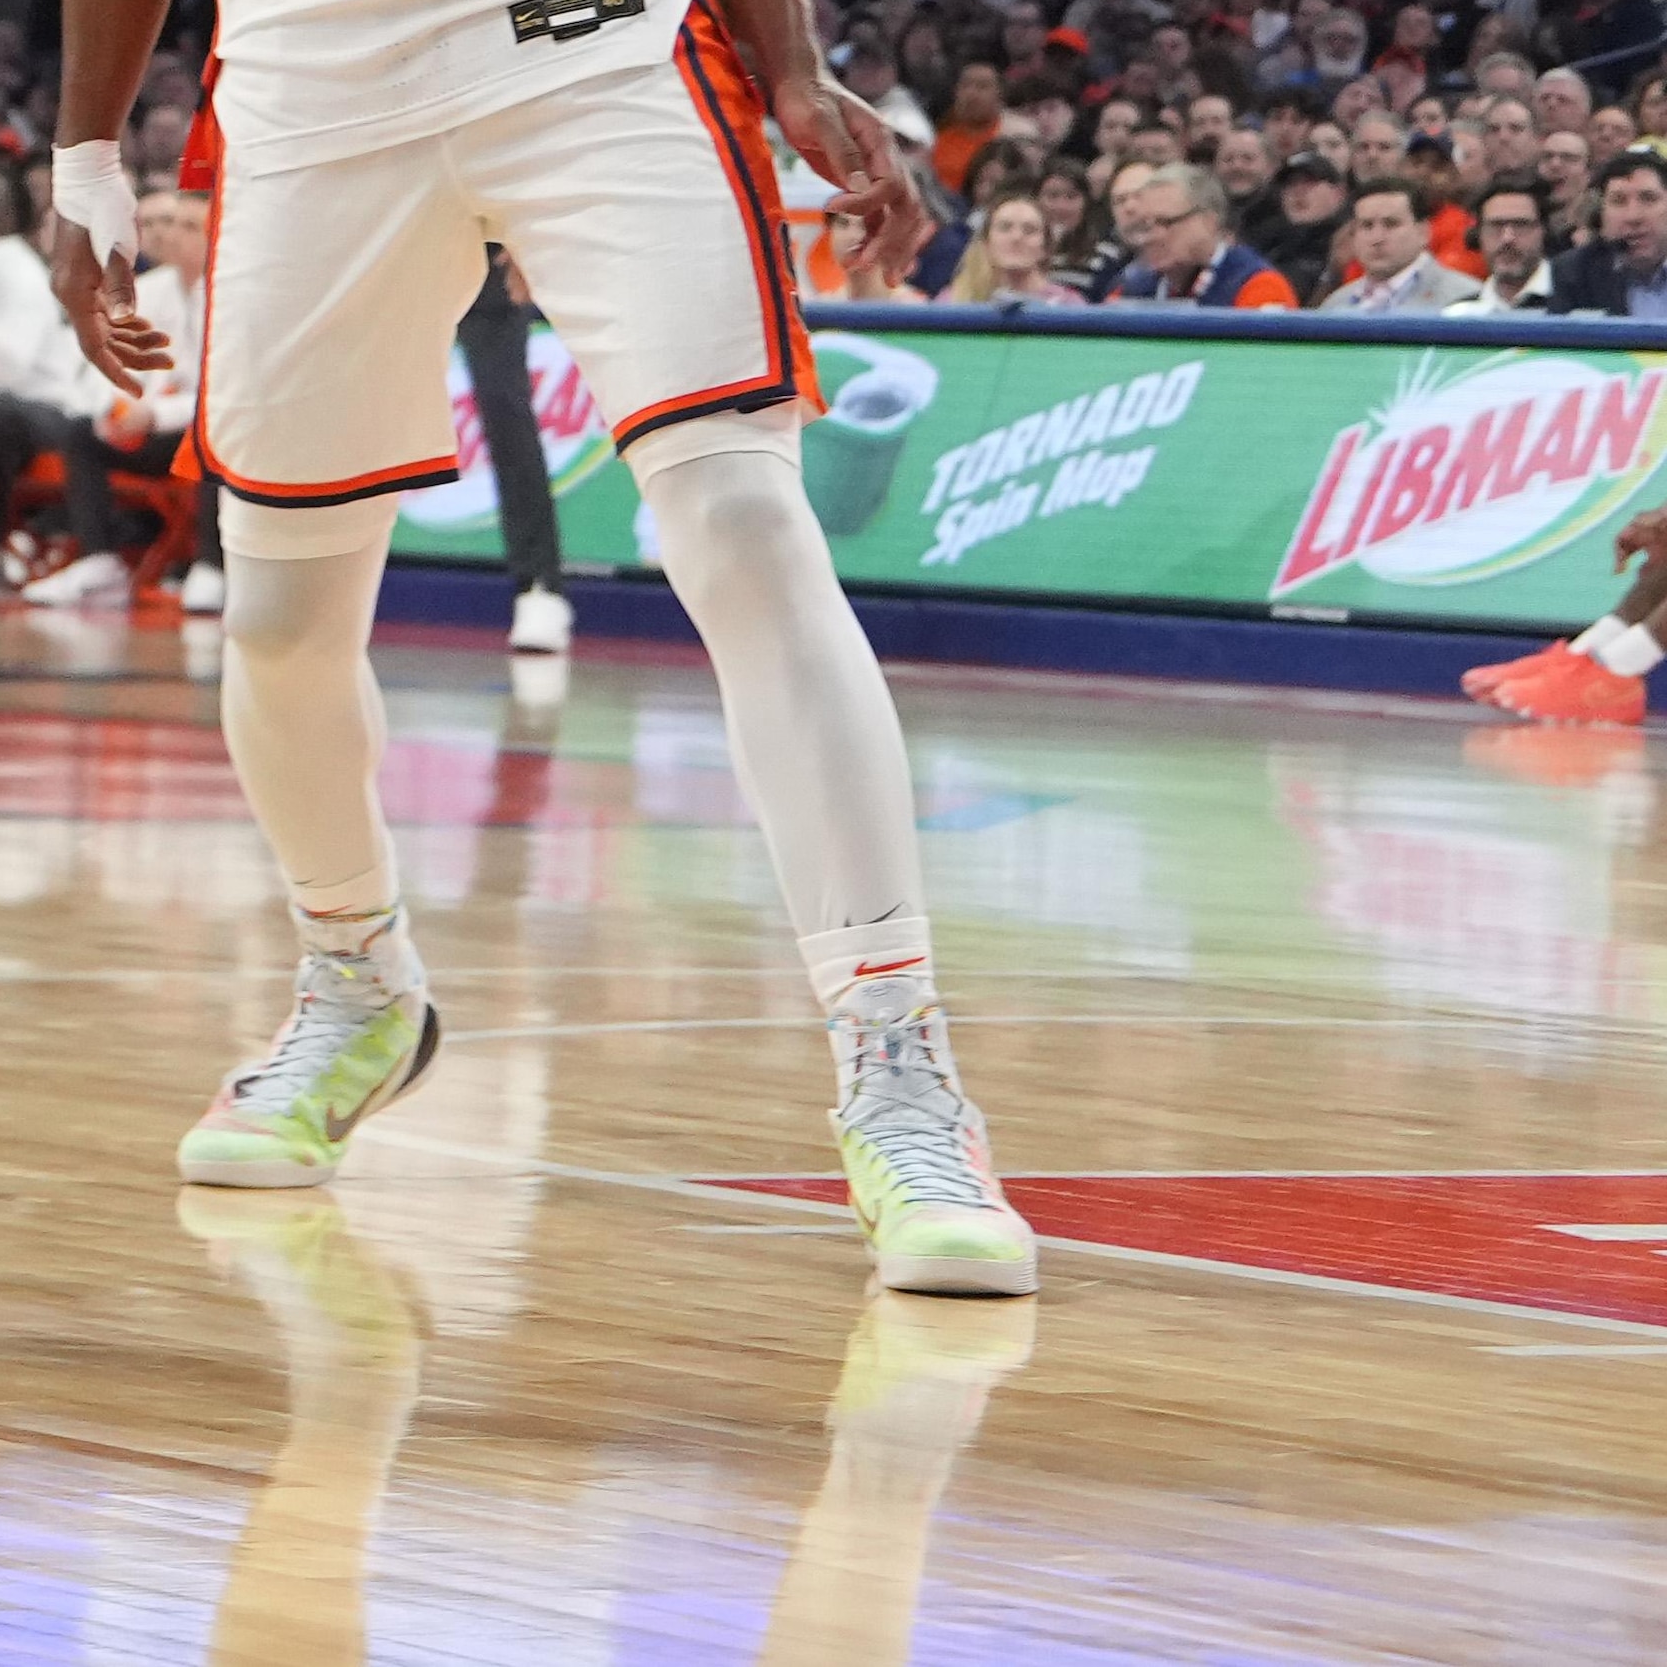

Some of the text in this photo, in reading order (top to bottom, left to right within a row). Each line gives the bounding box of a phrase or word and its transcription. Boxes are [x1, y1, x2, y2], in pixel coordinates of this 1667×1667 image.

[919, 445, 1158, 566] Spin Mop
[920, 359, 1206, 514] TORNADO
[1273, 368, 1666, 590] LIBMAN
